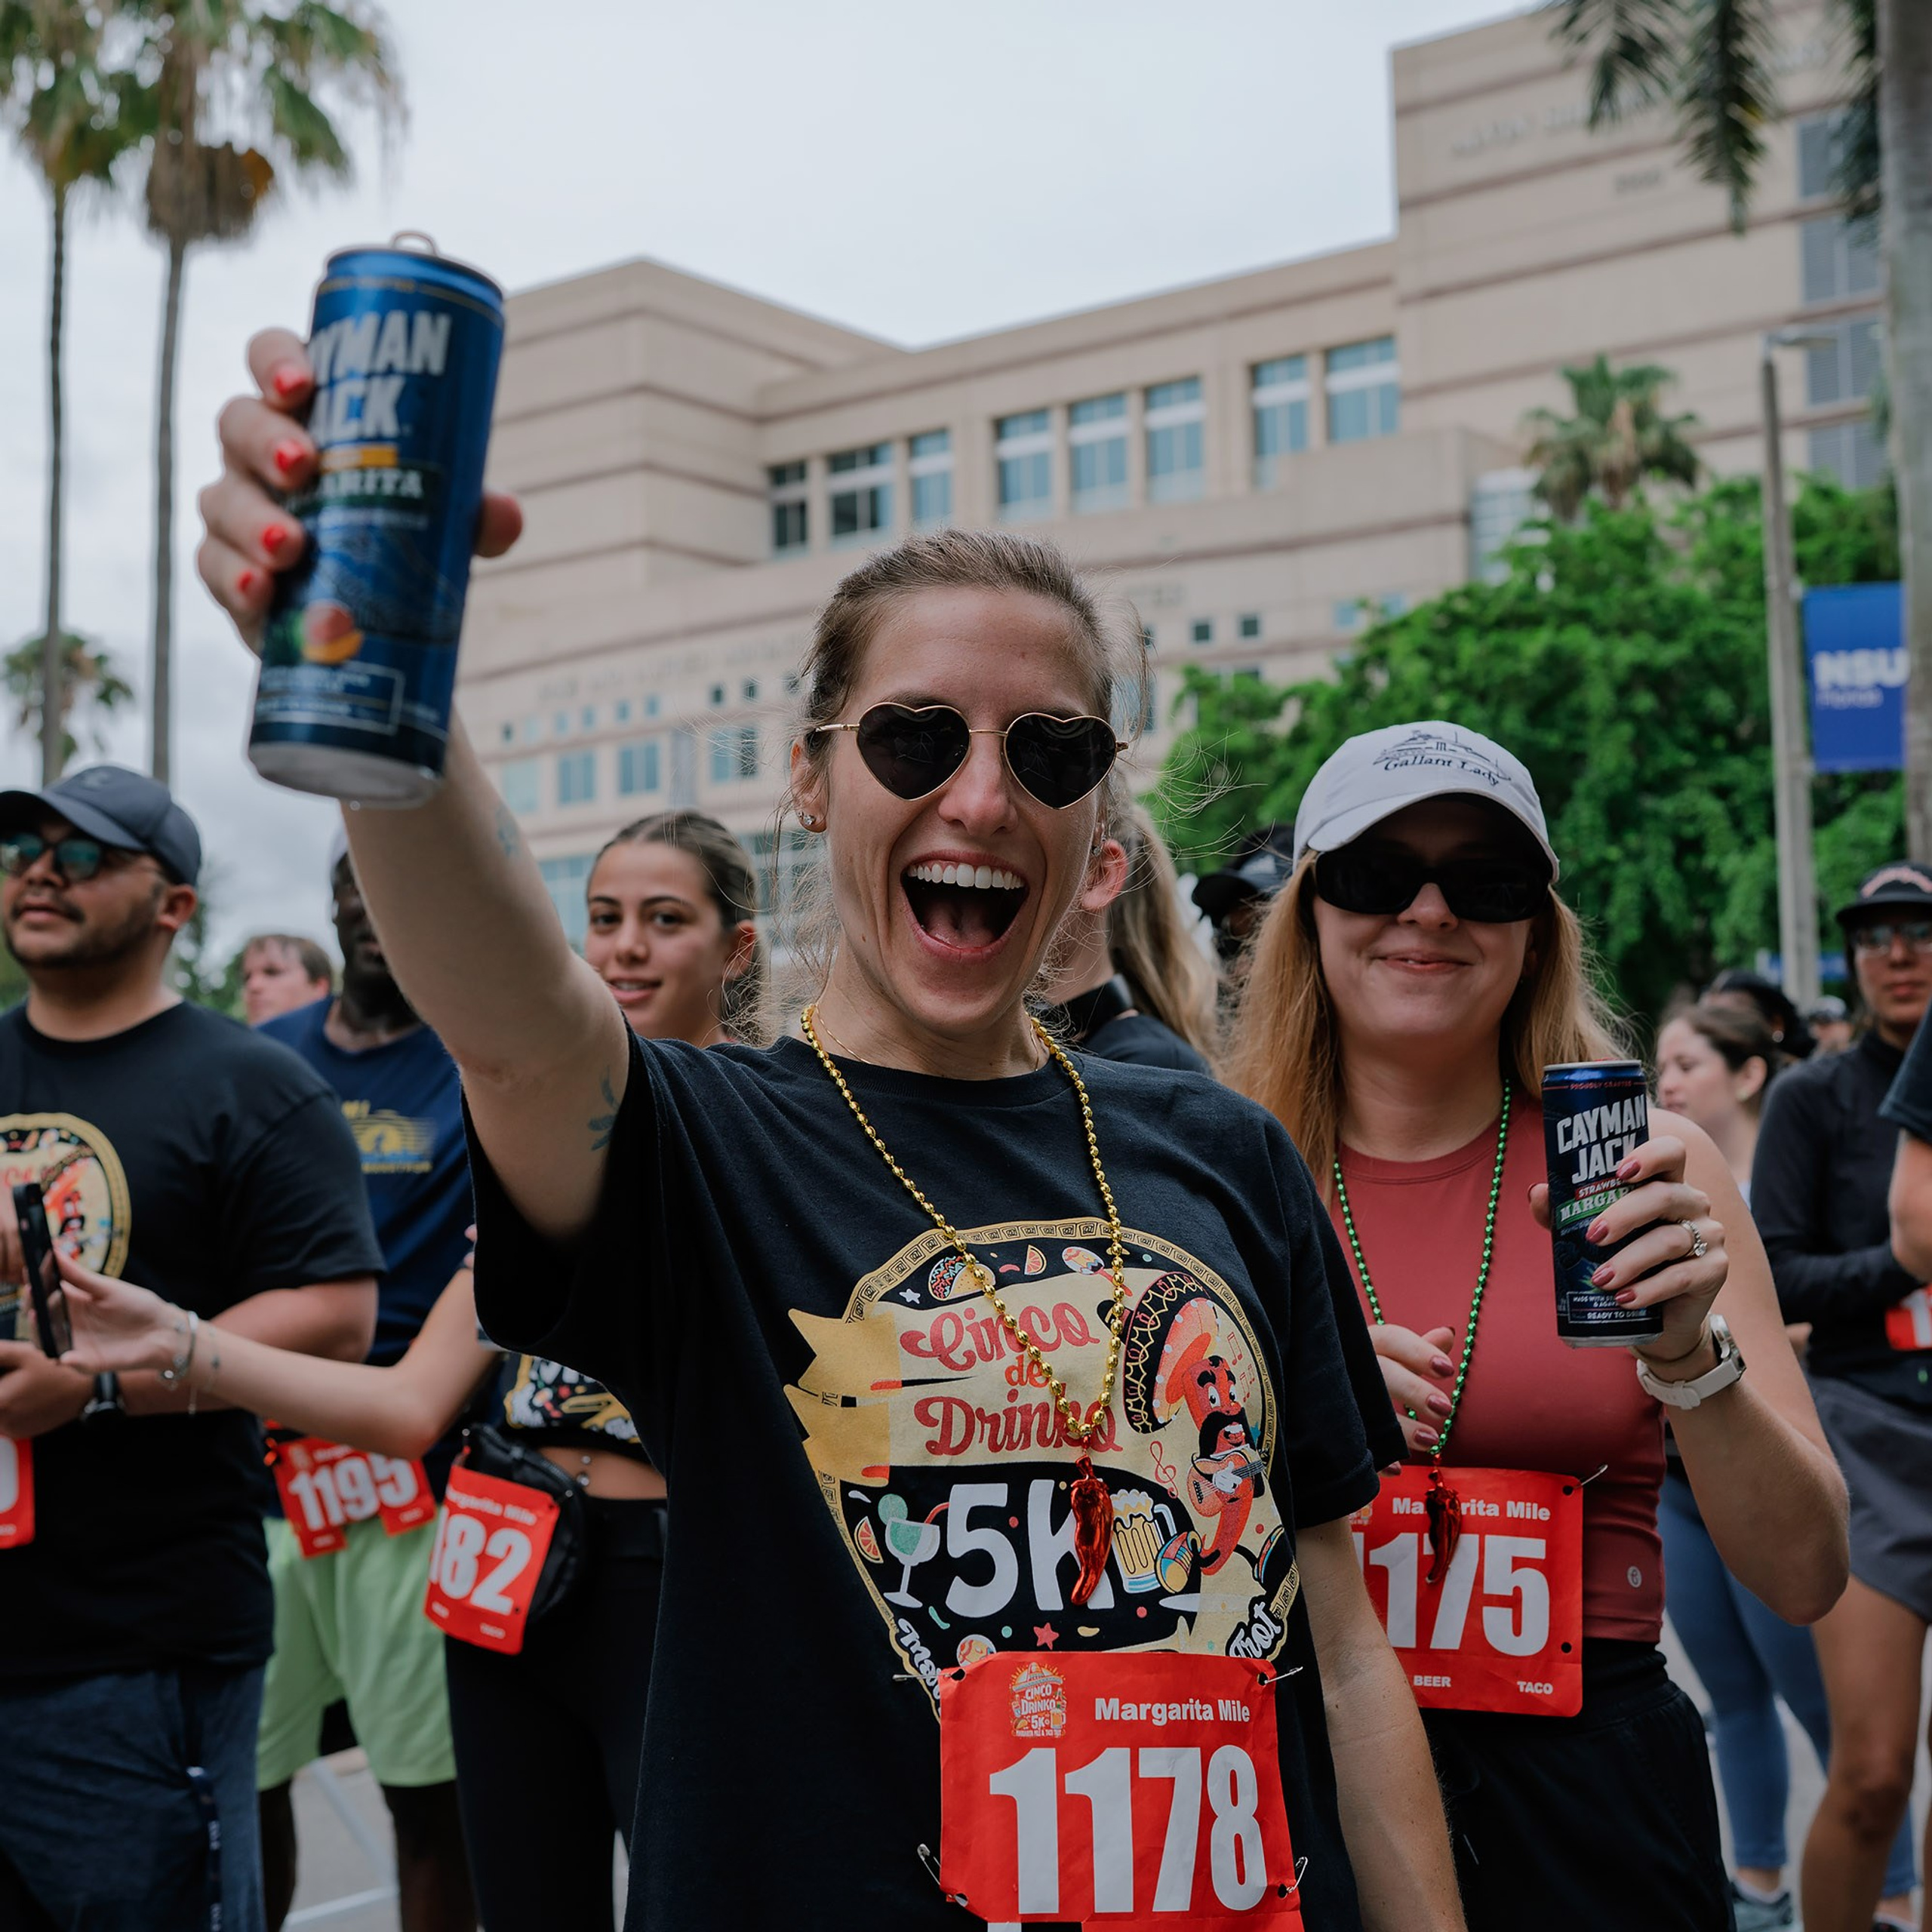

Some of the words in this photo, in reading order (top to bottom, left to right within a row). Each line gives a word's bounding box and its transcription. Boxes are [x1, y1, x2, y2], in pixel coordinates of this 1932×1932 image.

[309, 309, 454, 386] YMAN
[308, 374, 405, 447] ACK
[1384, 755, 1452, 771] Gallant
[1457, 761, 1500, 786] Lady
[1557, 1094, 1646, 1154] CAYMAN
[1571, 1132, 1636, 1184] JACK
[1560, 1184, 1633, 1222] MARGAR
[1578, 1178, 1623, 1198] STRAWBE
[1586, 1312, 1612, 1320] READY
[900, 1302, 1100, 1371] Cinco
[1004, 1354, 1050, 1388] de
[914, 1383, 1123, 1456] Drinko
[288, 1452, 419, 1532] 1195
[1392, 1497, 1500, 1518] Marita
[1506, 1500, 1551, 1521] Mile
[945, 1478, 1115, 1618] 5K
[1229, 1601, 1281, 1659] Trot
[1025, 1684, 1052, 1700] CINCO
[1413, 1675, 1451, 1687] BEER
[1517, 1681, 1553, 1695] TACO
[1020, 1698, 1056, 1715] DRINKO
[1031, 1714, 1046, 1729] 5K
[1095, 1697, 1214, 1726] Margarita
[1217, 1699, 1251, 1722] Mile
[989, 1744, 1268, 1915] 1178
